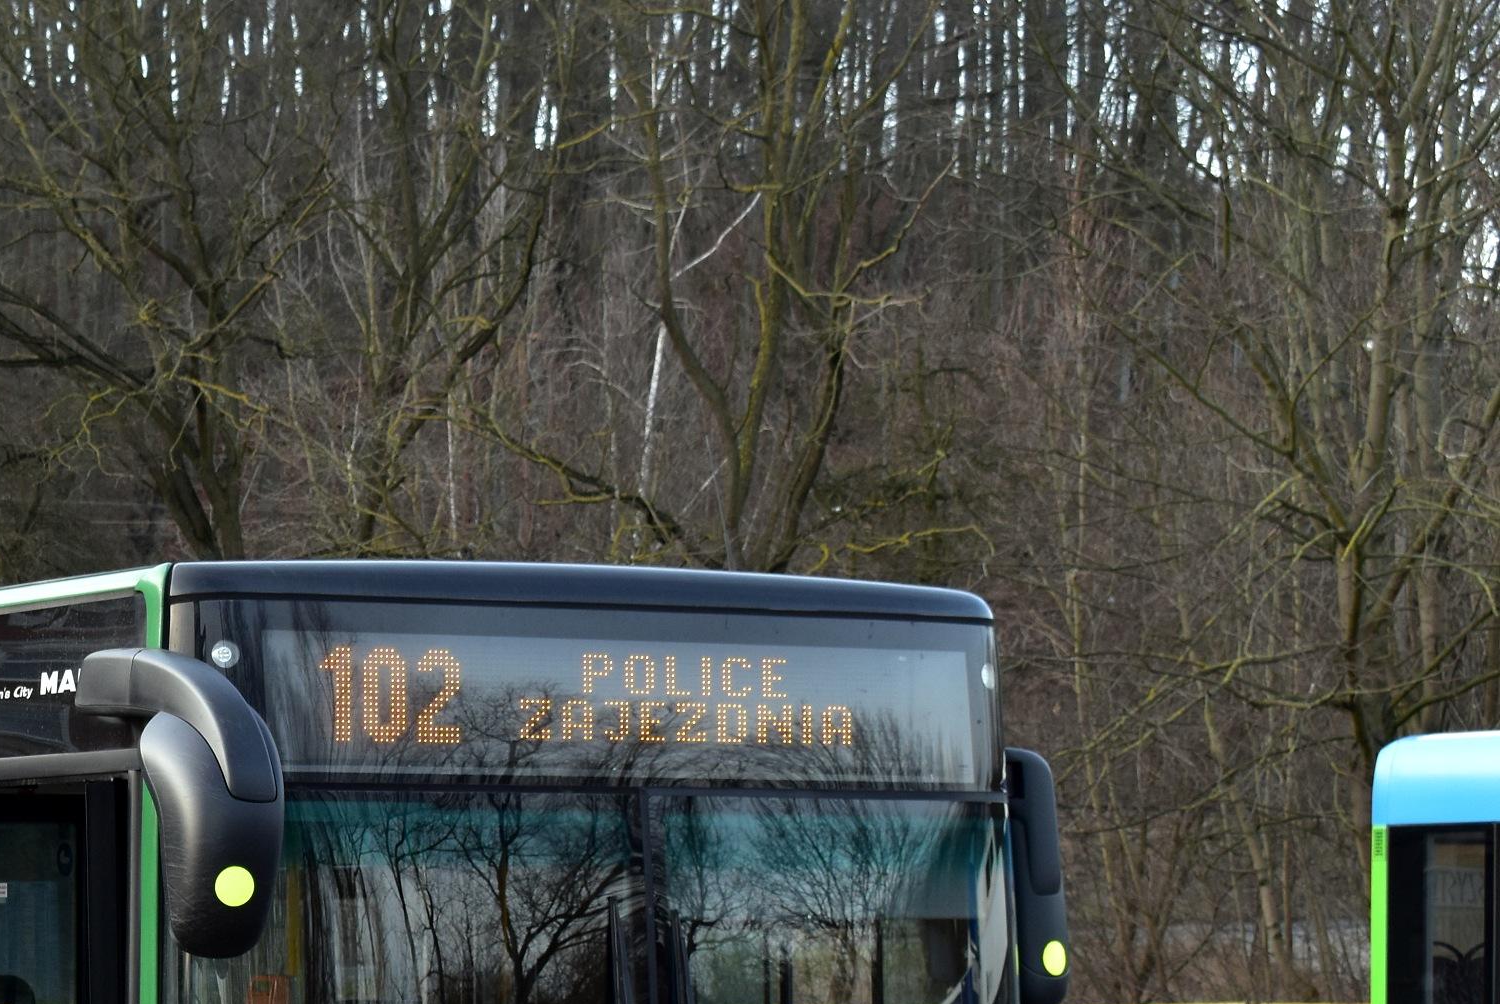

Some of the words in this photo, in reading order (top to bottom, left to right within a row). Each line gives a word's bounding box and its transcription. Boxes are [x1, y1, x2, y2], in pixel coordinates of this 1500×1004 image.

[13, 686, 34, 700] City
[318, 644, 462, 744] 102
[582, 652, 788, 698] POLICE
[520, 698, 854, 746] ZAJEZDNIA
